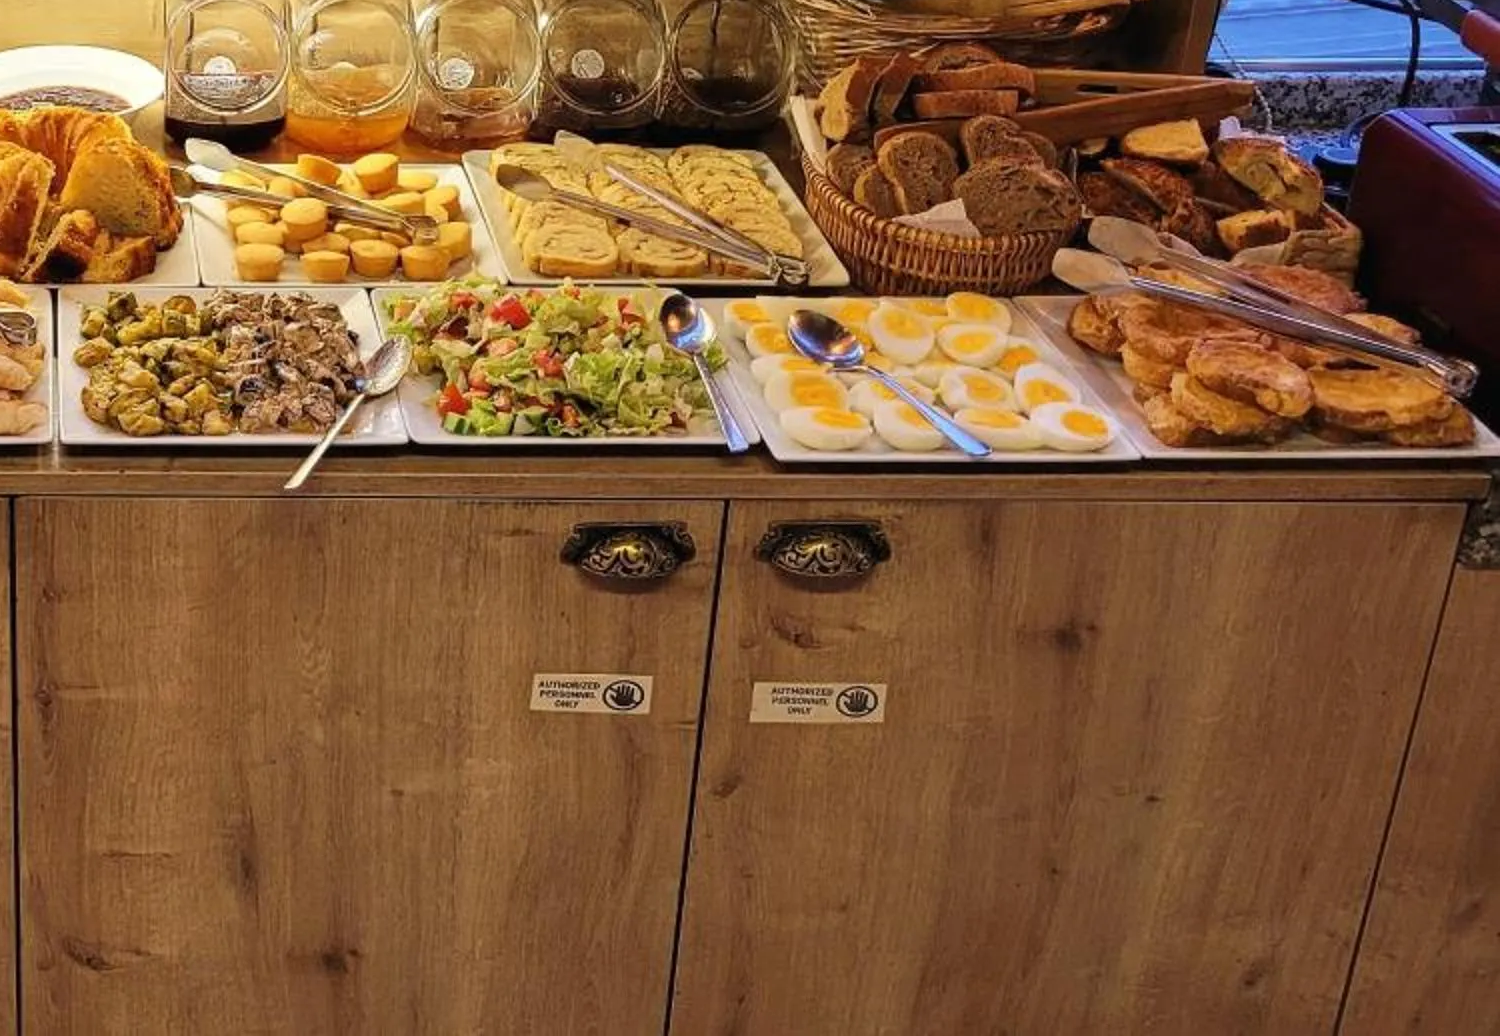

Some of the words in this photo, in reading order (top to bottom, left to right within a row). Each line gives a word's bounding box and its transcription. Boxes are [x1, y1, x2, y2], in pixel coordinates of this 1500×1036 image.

[539, 680, 601, 690] AUTHORIZED
[771, 687, 835, 697] AUTHORIZED
[553, 699, 579, 709] ONLY
[787, 706, 813, 715] ONLY
